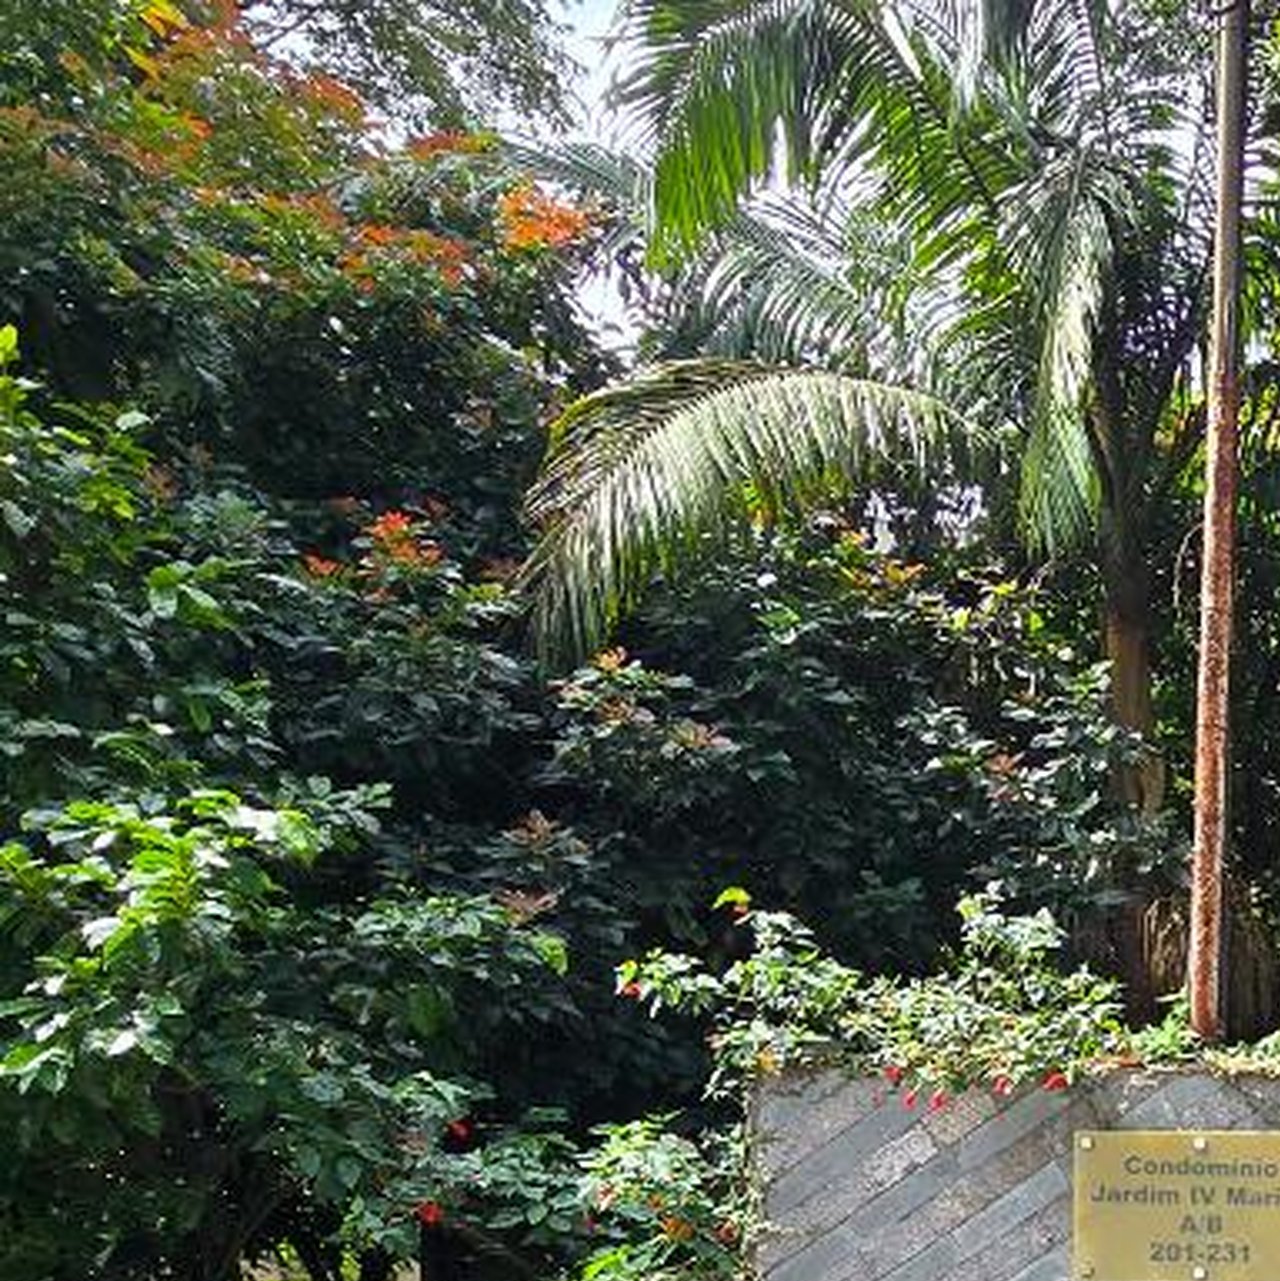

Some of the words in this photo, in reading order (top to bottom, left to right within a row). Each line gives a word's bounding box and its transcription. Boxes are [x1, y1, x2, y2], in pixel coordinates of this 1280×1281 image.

[1090, 1184, 1179, 1206] Jardim
[1190, 1186, 1215, 1206] IV
[1150, 1242, 1250, 1263] 201-231
